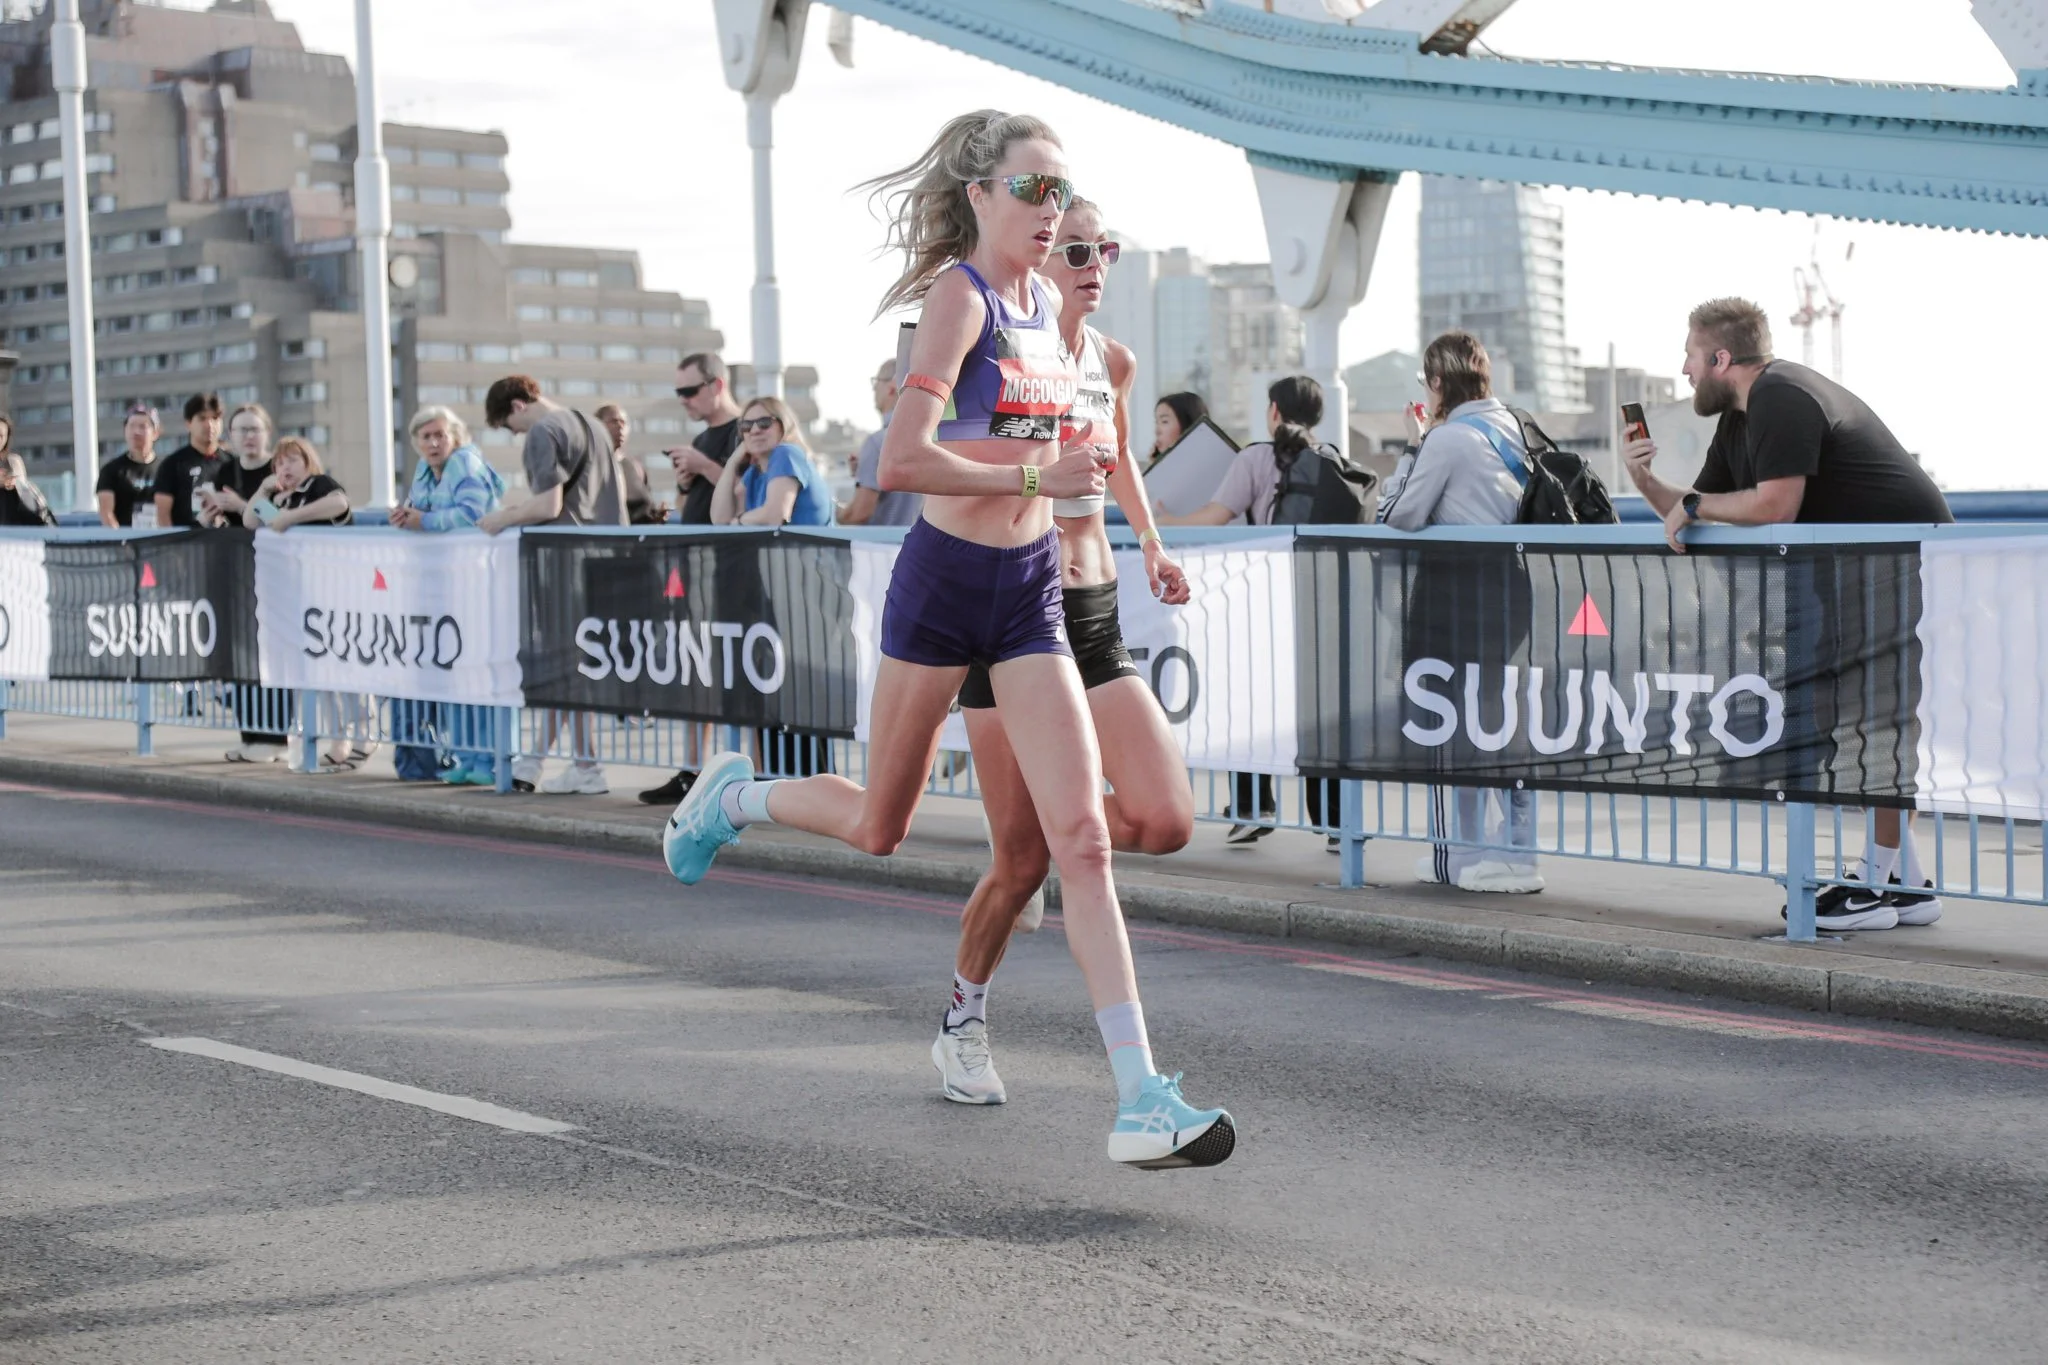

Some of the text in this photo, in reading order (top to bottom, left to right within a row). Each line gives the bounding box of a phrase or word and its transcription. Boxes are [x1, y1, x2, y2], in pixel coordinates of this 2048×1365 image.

[1034, 431, 1052, 439] new
[1026, 468, 1036, 491] ELITE
[87, 598, 217, 657] SUUNTO
[304, 607, 462, 671] SUUNTO
[575, 617, 785, 694] SUUNTO
[1401, 657, 1785, 758] SUUNTO
